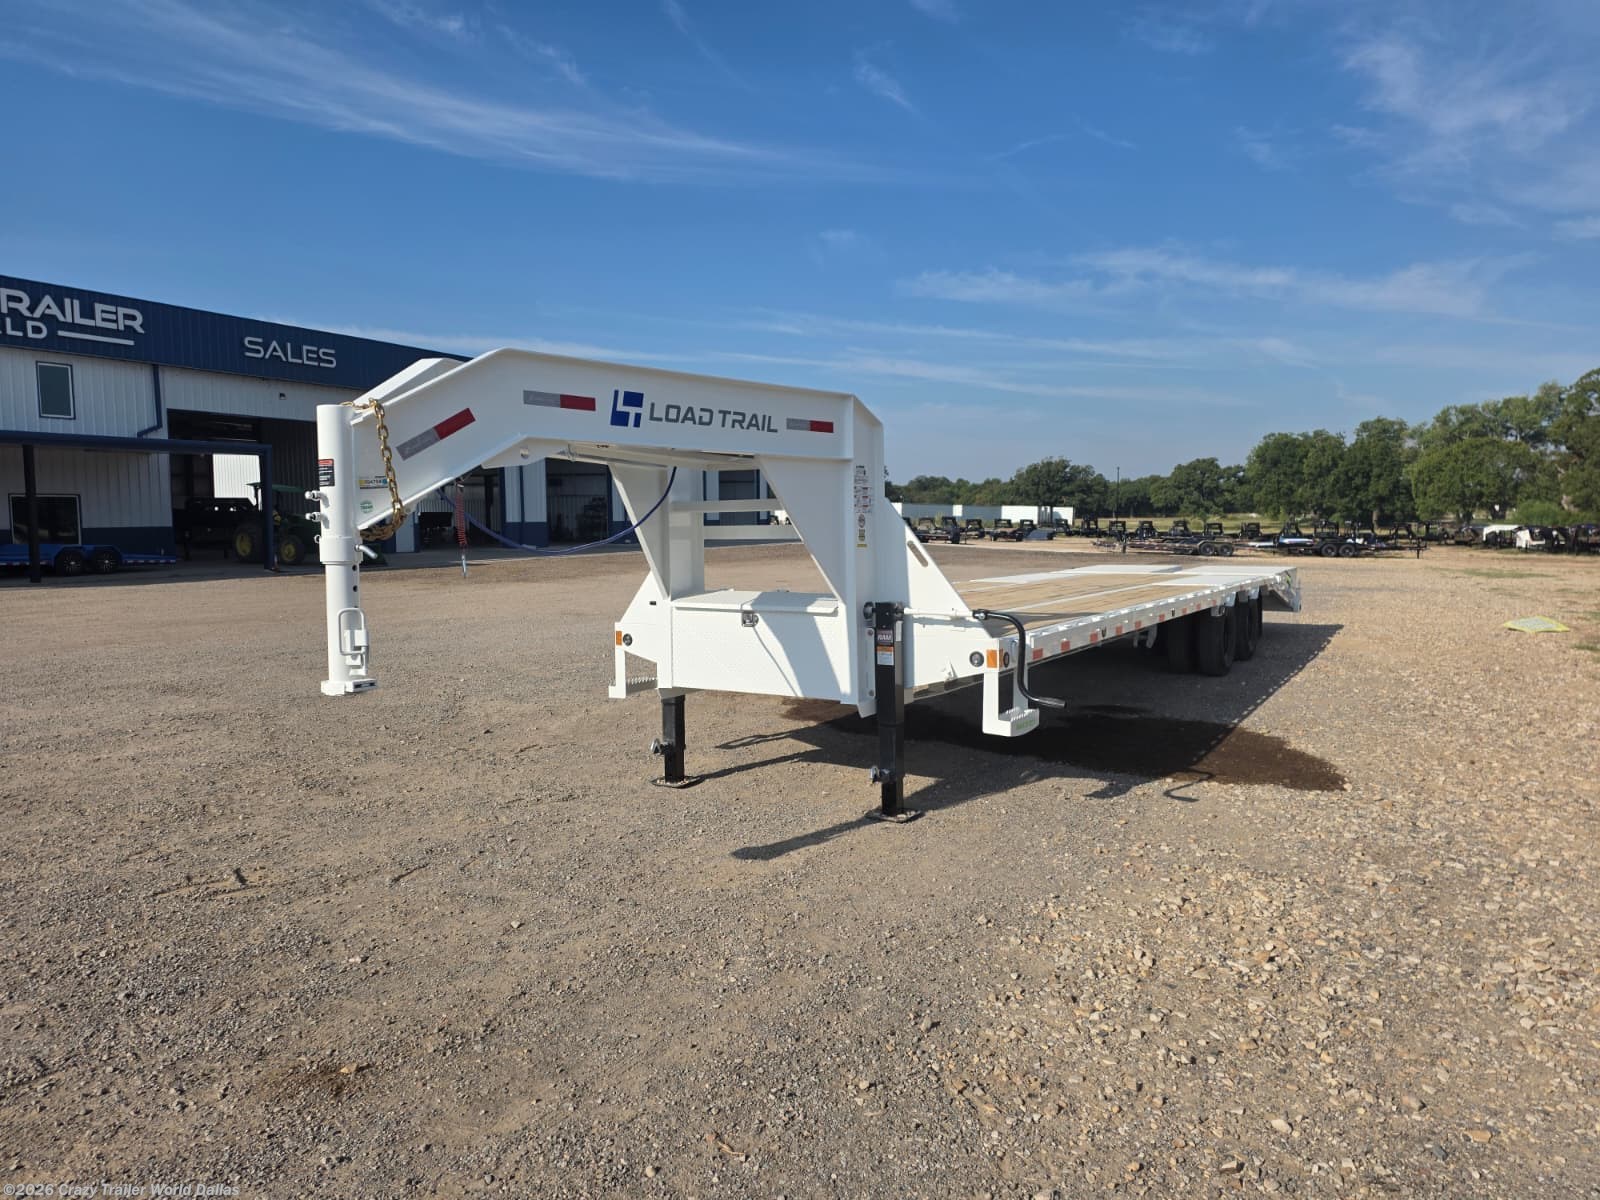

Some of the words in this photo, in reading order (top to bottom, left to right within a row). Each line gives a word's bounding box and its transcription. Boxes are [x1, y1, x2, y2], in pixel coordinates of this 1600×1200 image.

[0, 317, 48, 339] LD
[244, 336, 337, 368] SALES
[649, 402, 714, 426] LOAD
[718, 409, 778, 433] TRAIL
